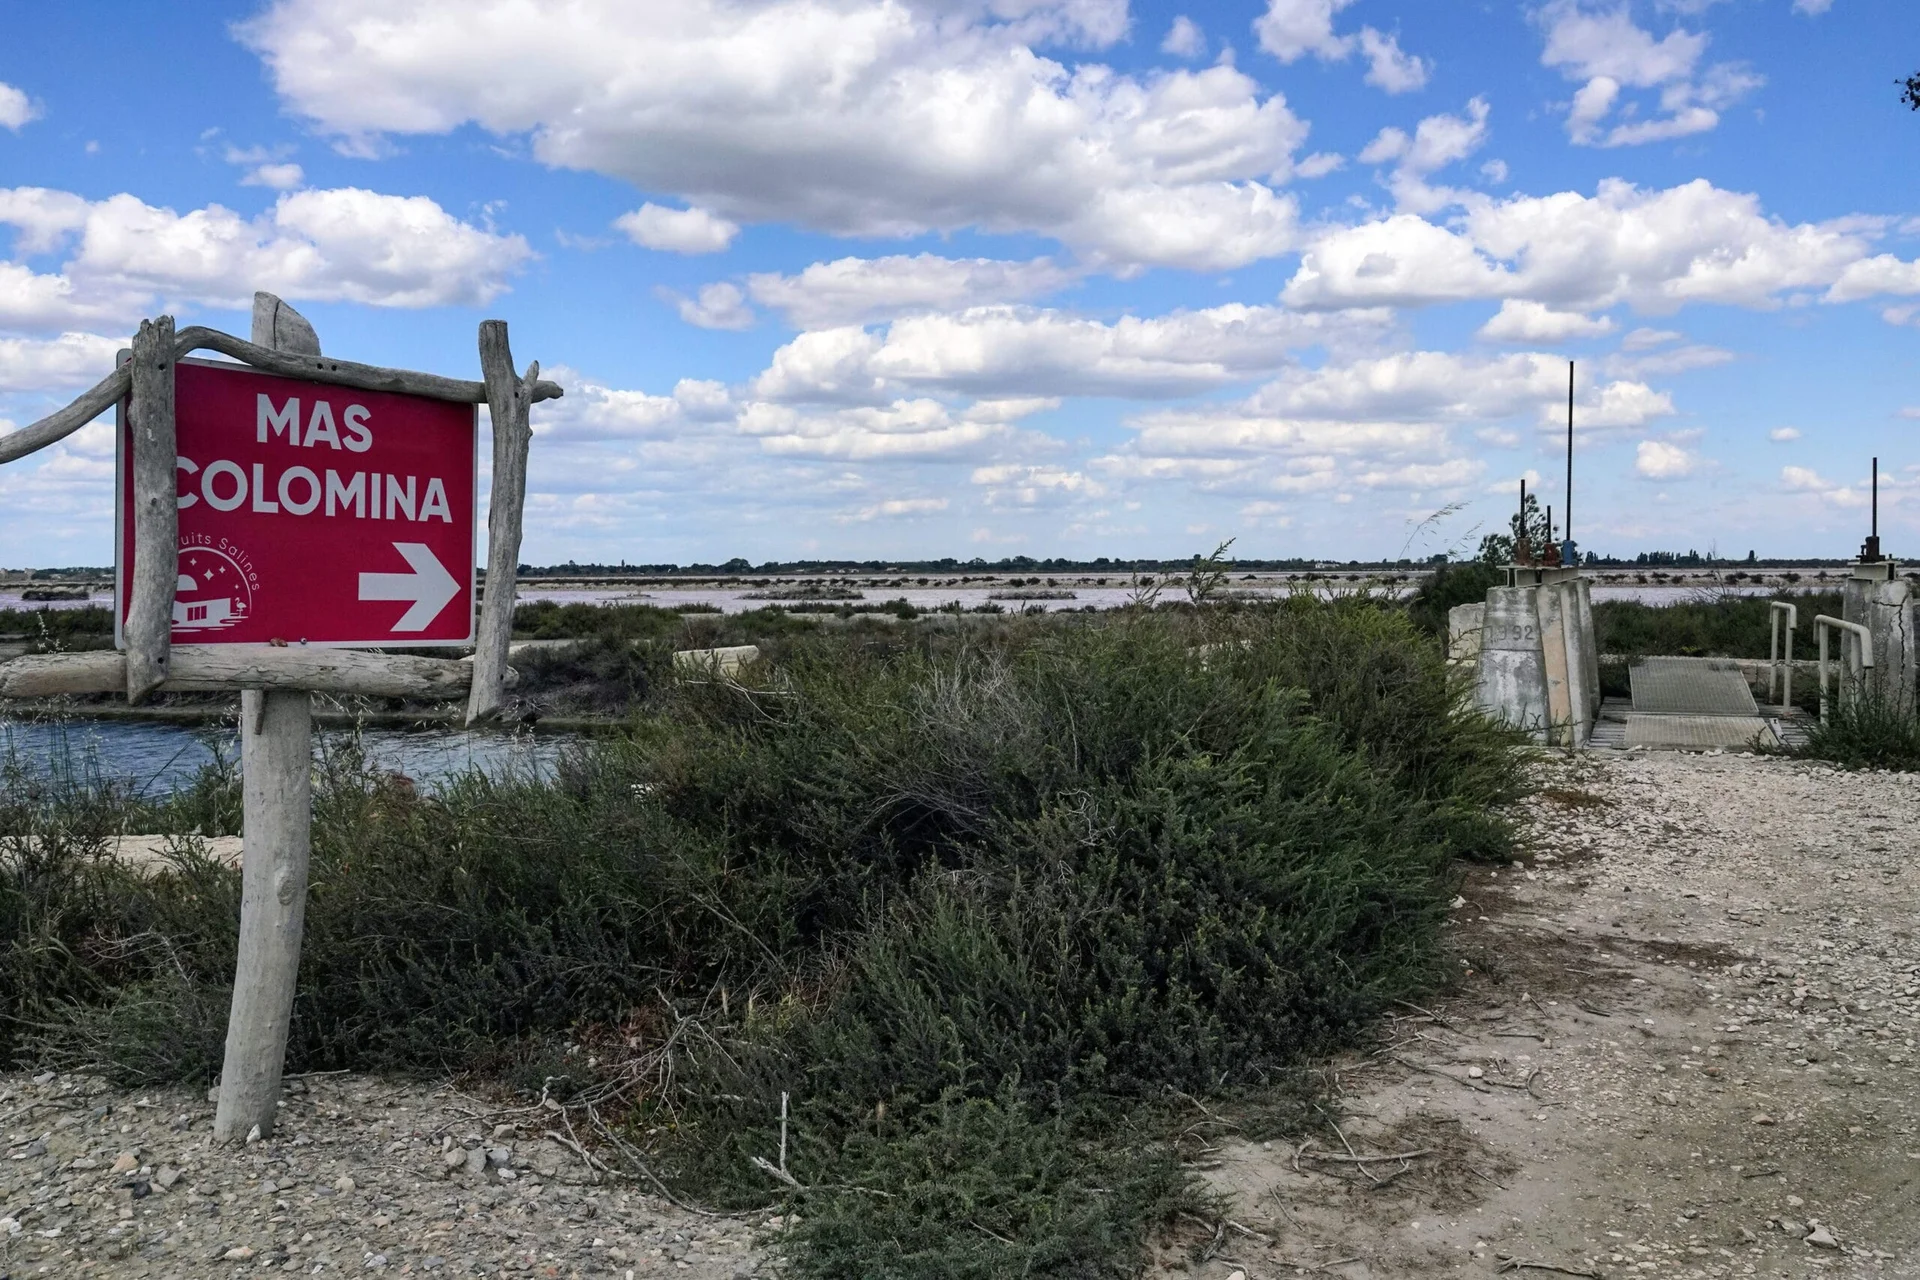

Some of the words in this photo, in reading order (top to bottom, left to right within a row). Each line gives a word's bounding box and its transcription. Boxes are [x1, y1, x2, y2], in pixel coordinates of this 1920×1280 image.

[257, 393, 372, 453] MAS
[177, 456, 453, 523] COLOMINA
[180, 532, 211, 545] uits
[219, 537, 260, 591] Salines
